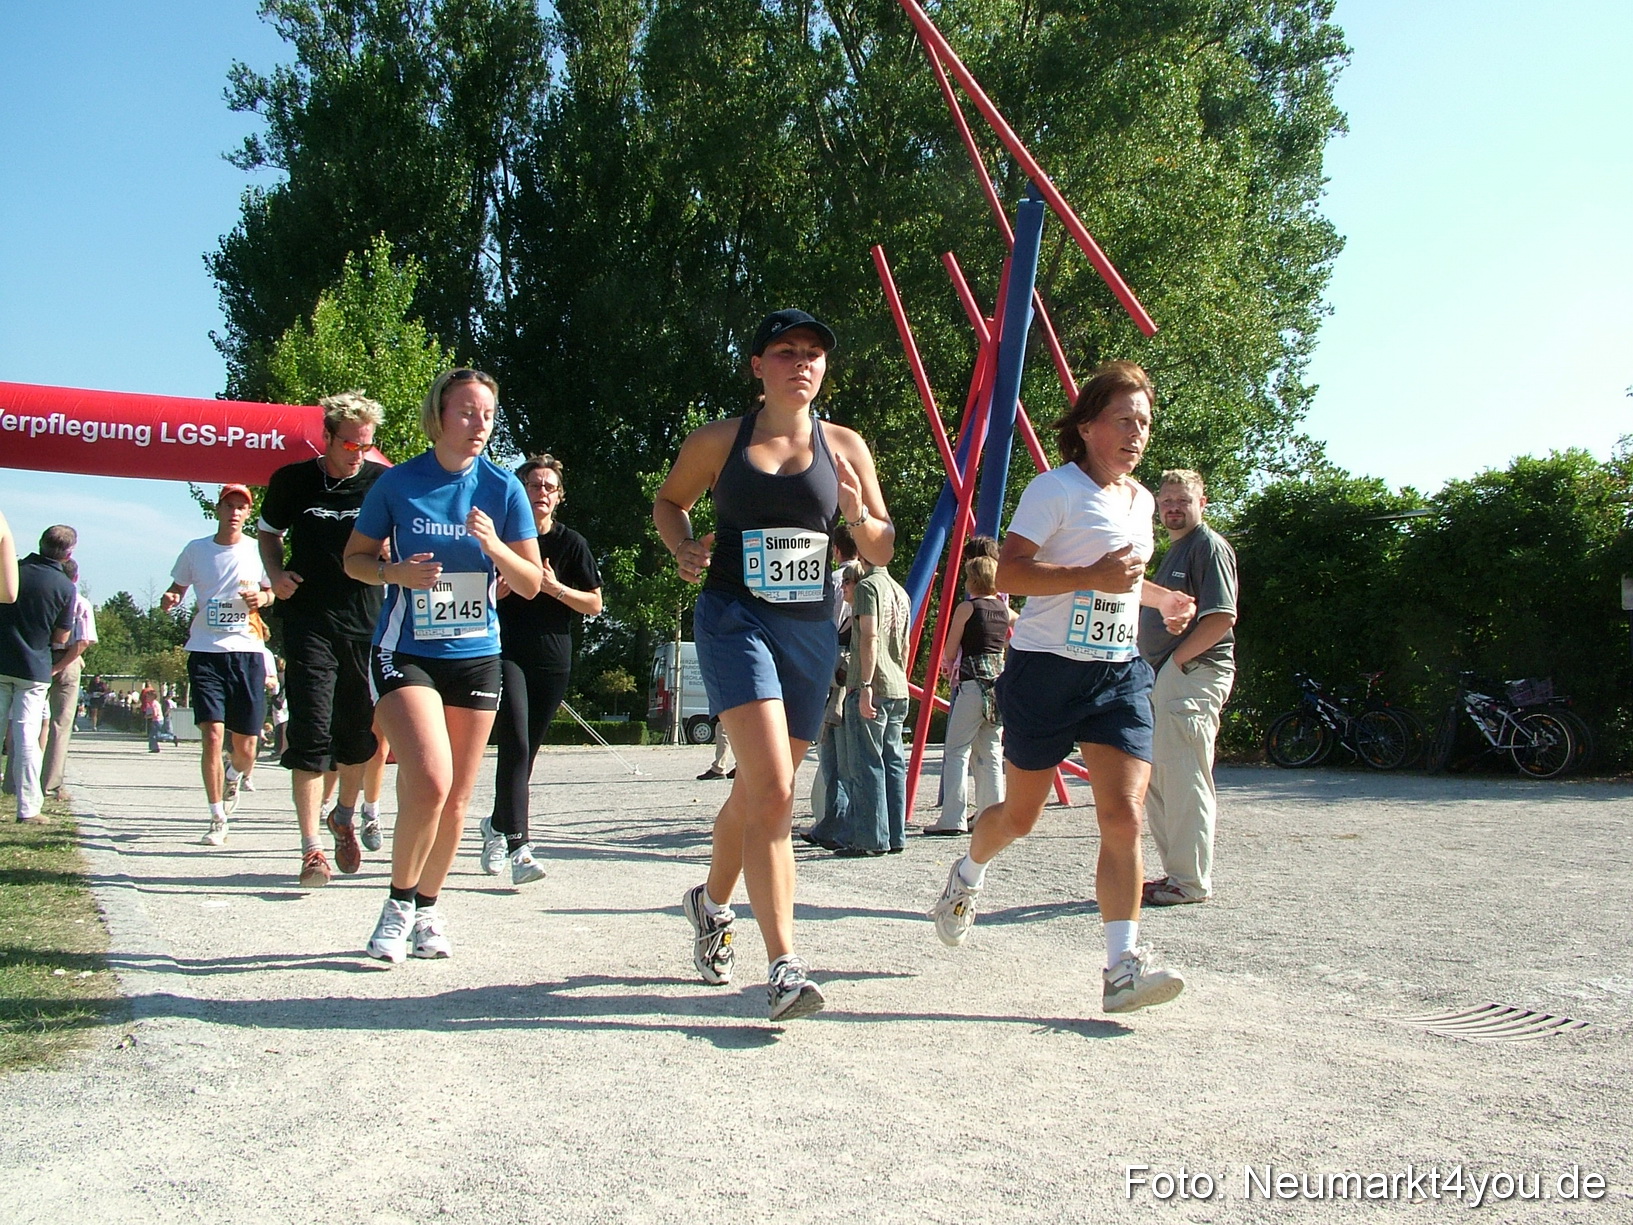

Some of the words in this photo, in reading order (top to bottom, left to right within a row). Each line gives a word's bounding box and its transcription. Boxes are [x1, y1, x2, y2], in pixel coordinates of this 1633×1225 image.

[160, 421, 286, 450] LGS-Park
[412, 517, 471, 540] Sinup
[765, 536, 811, 550] Simone
[749, 557, 759, 569] D
[769, 560, 820, 582] 3183
[431, 580, 453, 592] Kim
[219, 612, 247, 623] 2239
[416, 598, 426, 609] C
[434, 600, 482, 621] 2145
[1075, 614, 1085, 625] D
[1091, 621, 1134, 643] 3184
